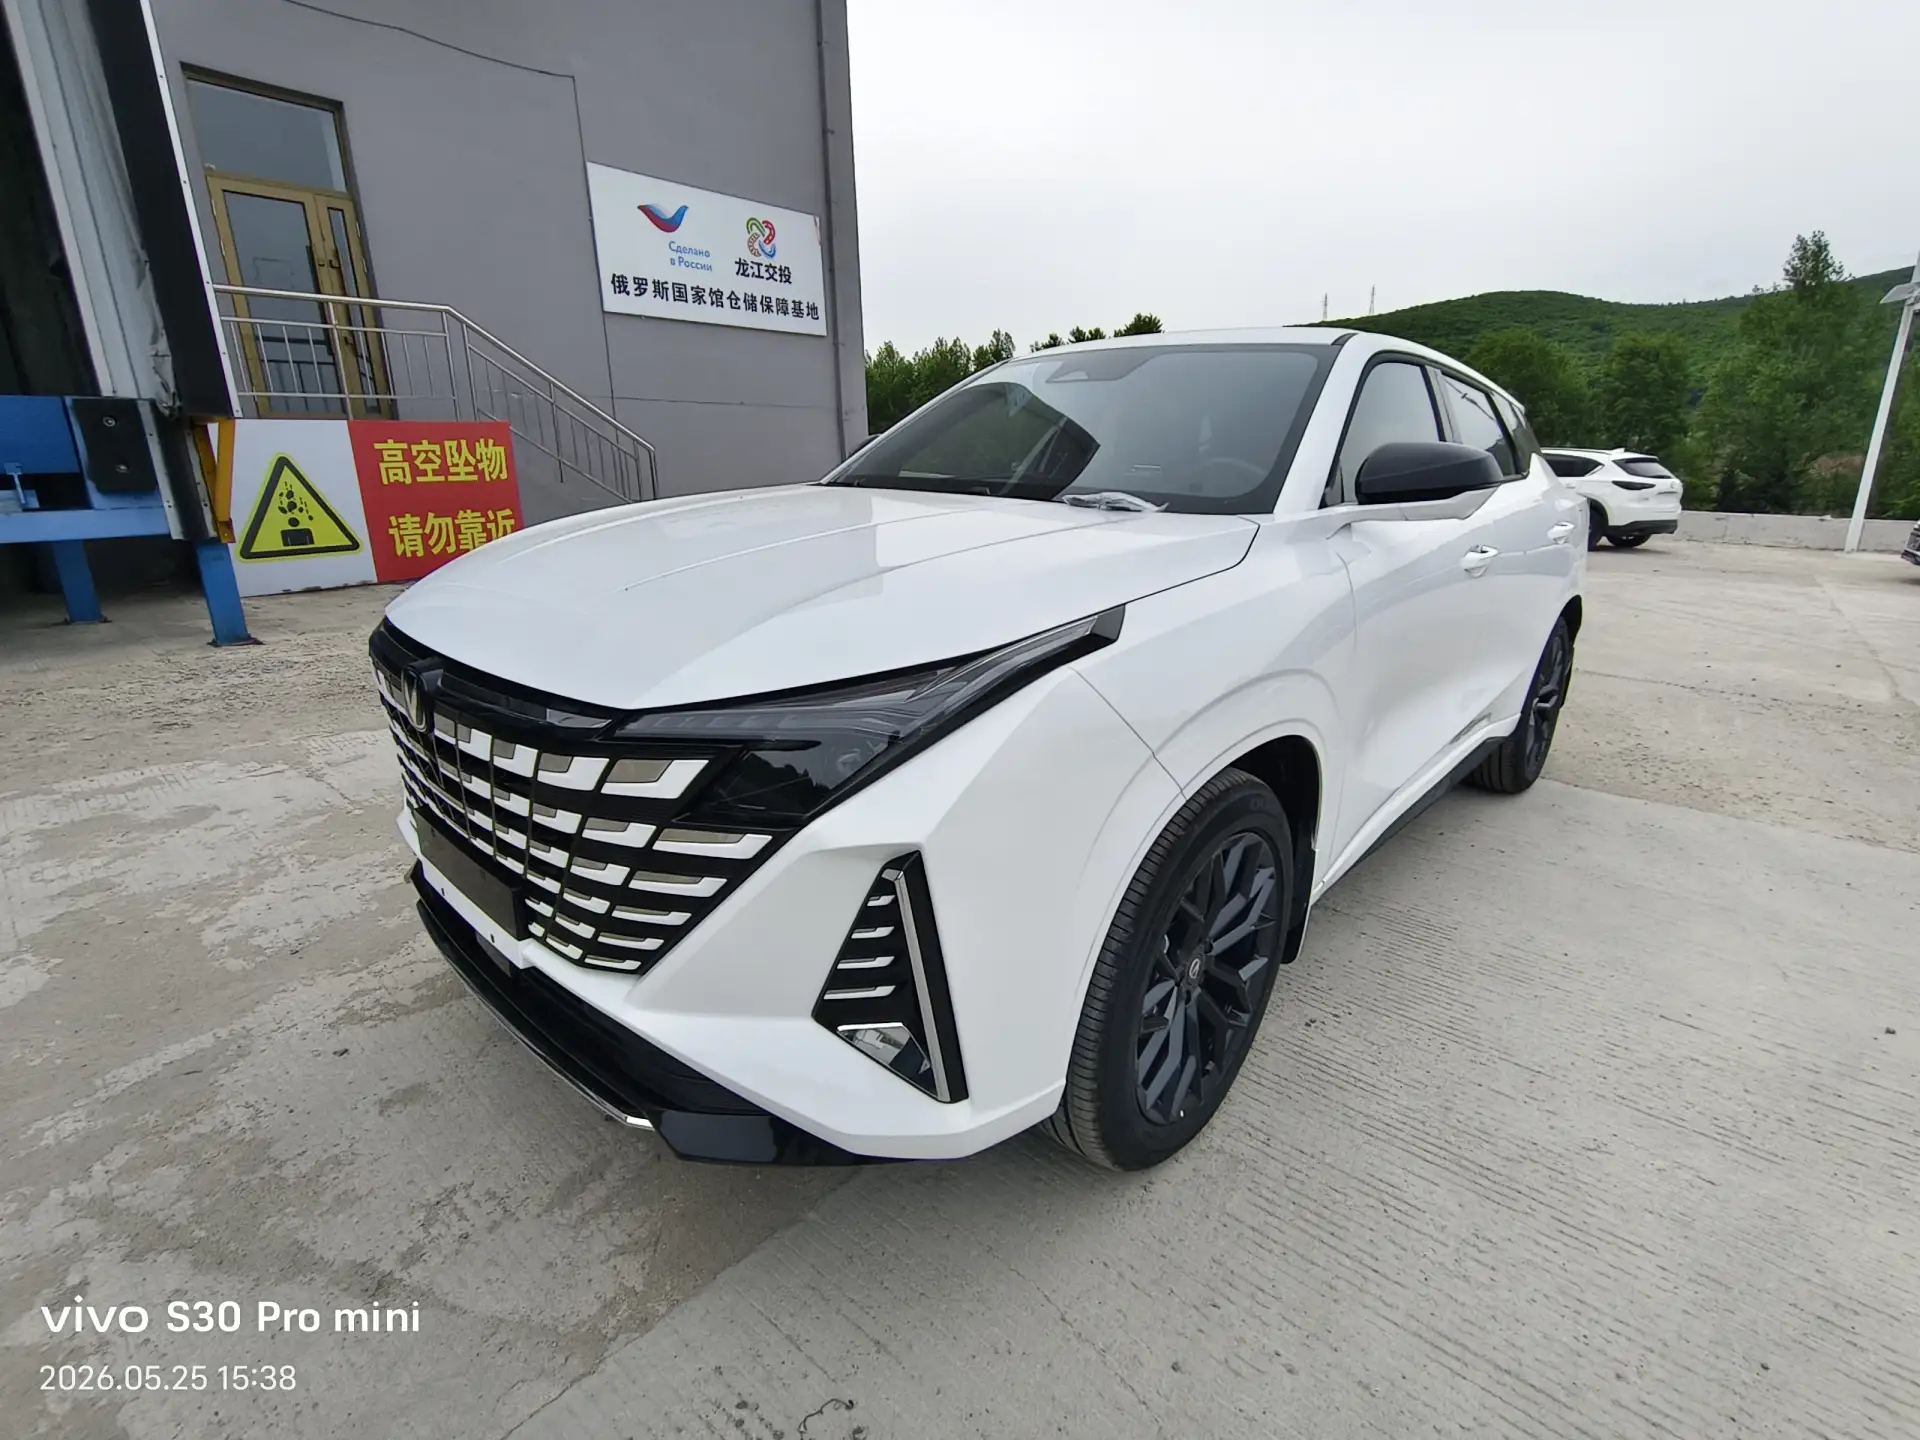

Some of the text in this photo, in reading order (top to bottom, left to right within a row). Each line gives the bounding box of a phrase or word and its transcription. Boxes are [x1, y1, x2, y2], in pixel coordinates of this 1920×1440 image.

[668, 240, 711, 258] Сделано
[669, 256, 713, 272] в России
[734, 257, 793, 285] 龙江交投
[610, 273, 820, 321] 俄罗斯国家馆仓储保障基地
[373, 438, 509, 486] 高空坠物
